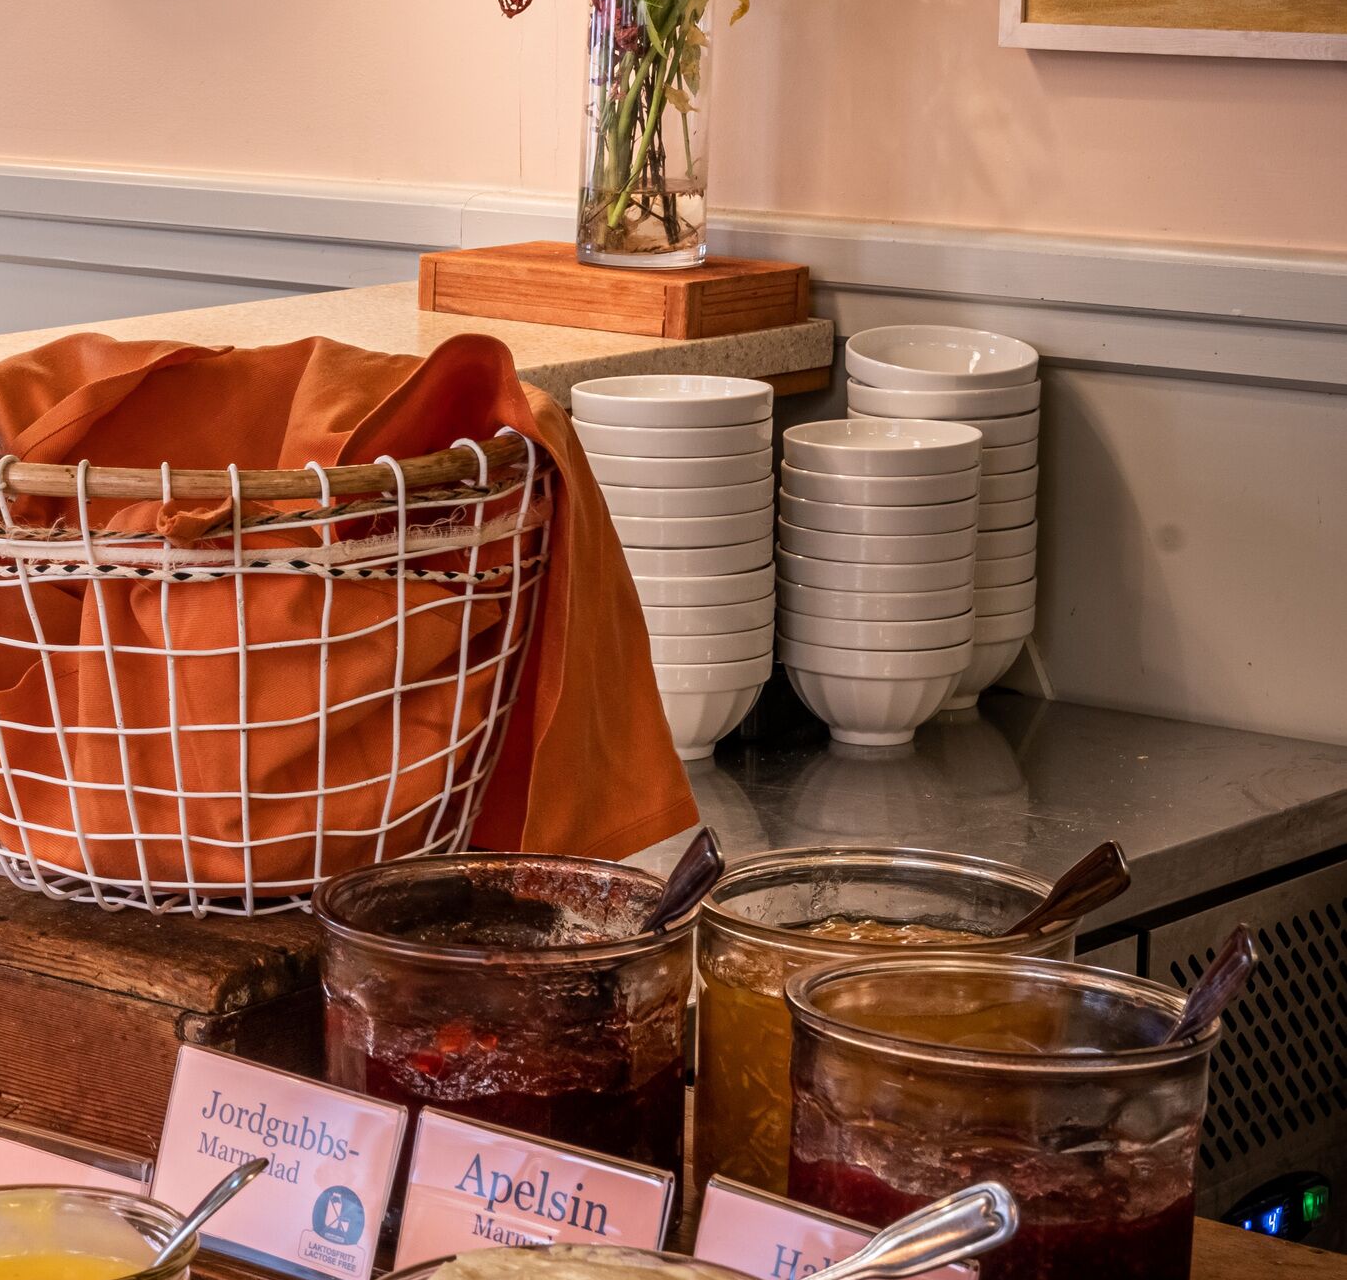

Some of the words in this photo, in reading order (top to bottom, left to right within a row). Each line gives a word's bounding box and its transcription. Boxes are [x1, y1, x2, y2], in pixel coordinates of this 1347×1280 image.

[201, 1090, 360, 1161] Jordgubbs-
[196, 1131, 301, 1184] Marmlad
[454, 1152, 608, 1236] Apelsin
[304, 1249, 337, 1267] LACTOSE
[336, 1257, 357, 1272] FREE
[307, 1241, 356, 1262] LAKTOSFRITT
